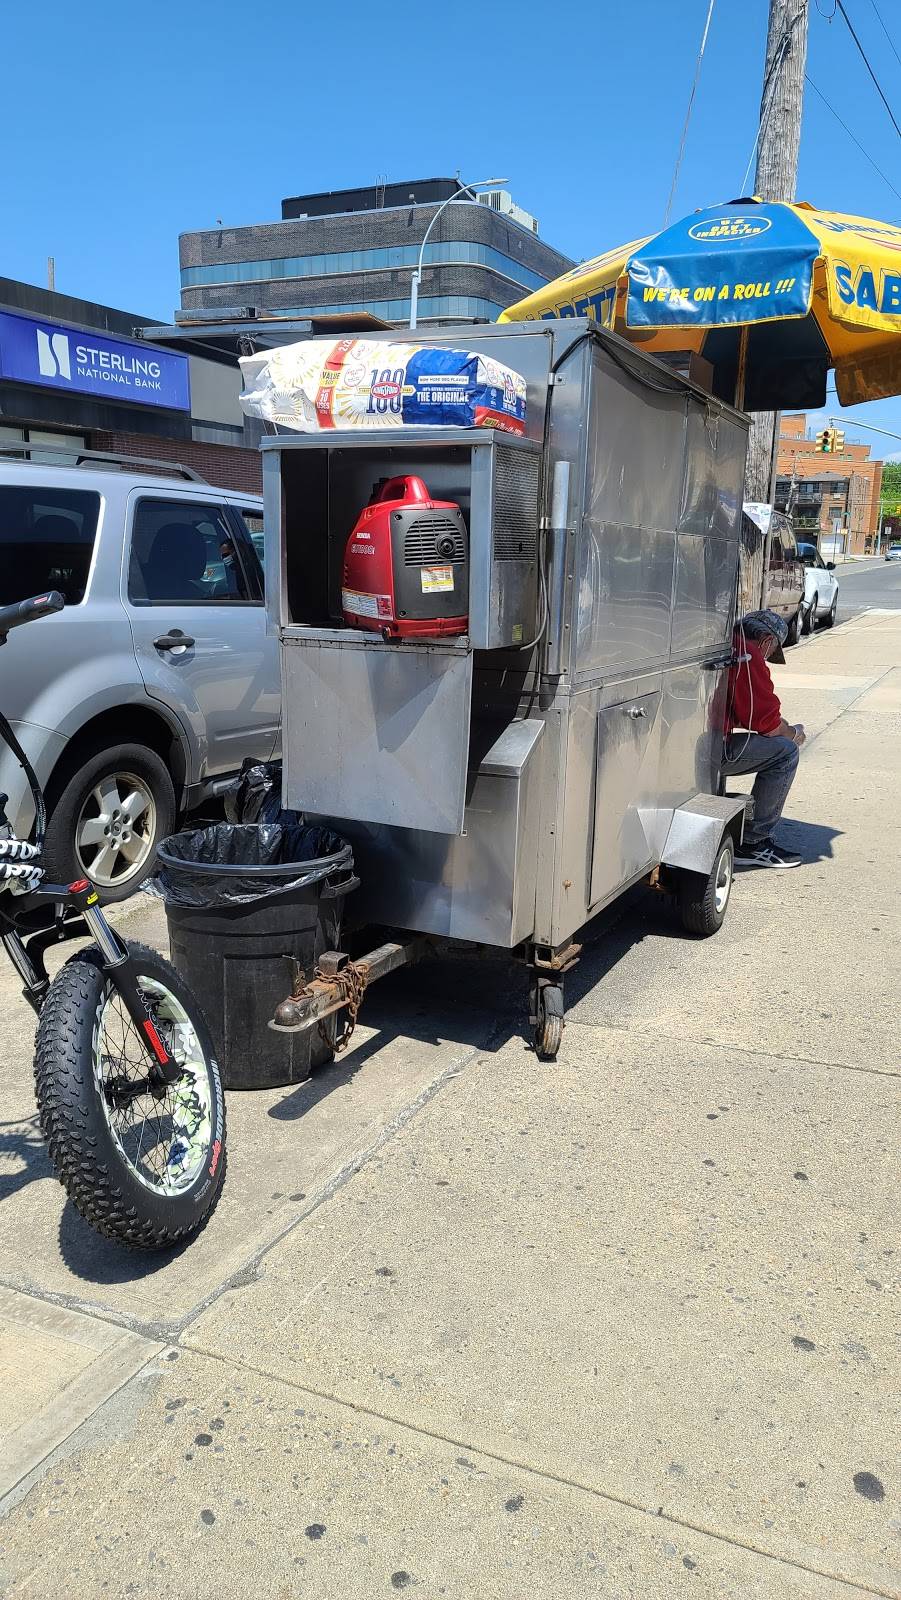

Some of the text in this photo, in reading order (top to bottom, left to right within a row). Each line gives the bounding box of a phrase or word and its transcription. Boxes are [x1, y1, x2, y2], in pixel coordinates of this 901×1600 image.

[697, 228, 761, 237] INSPECTED
[643, 278, 796, 302] WE'RE ON A ROLL !!!
[75, 345, 161, 378] STERLING
[77, 366, 161, 391] NATIONAL BANK
[321, 371, 341, 381] VALUE
[366, 369, 404, 413] 100
[416, 391, 470, 403] THE ORIGINAL
